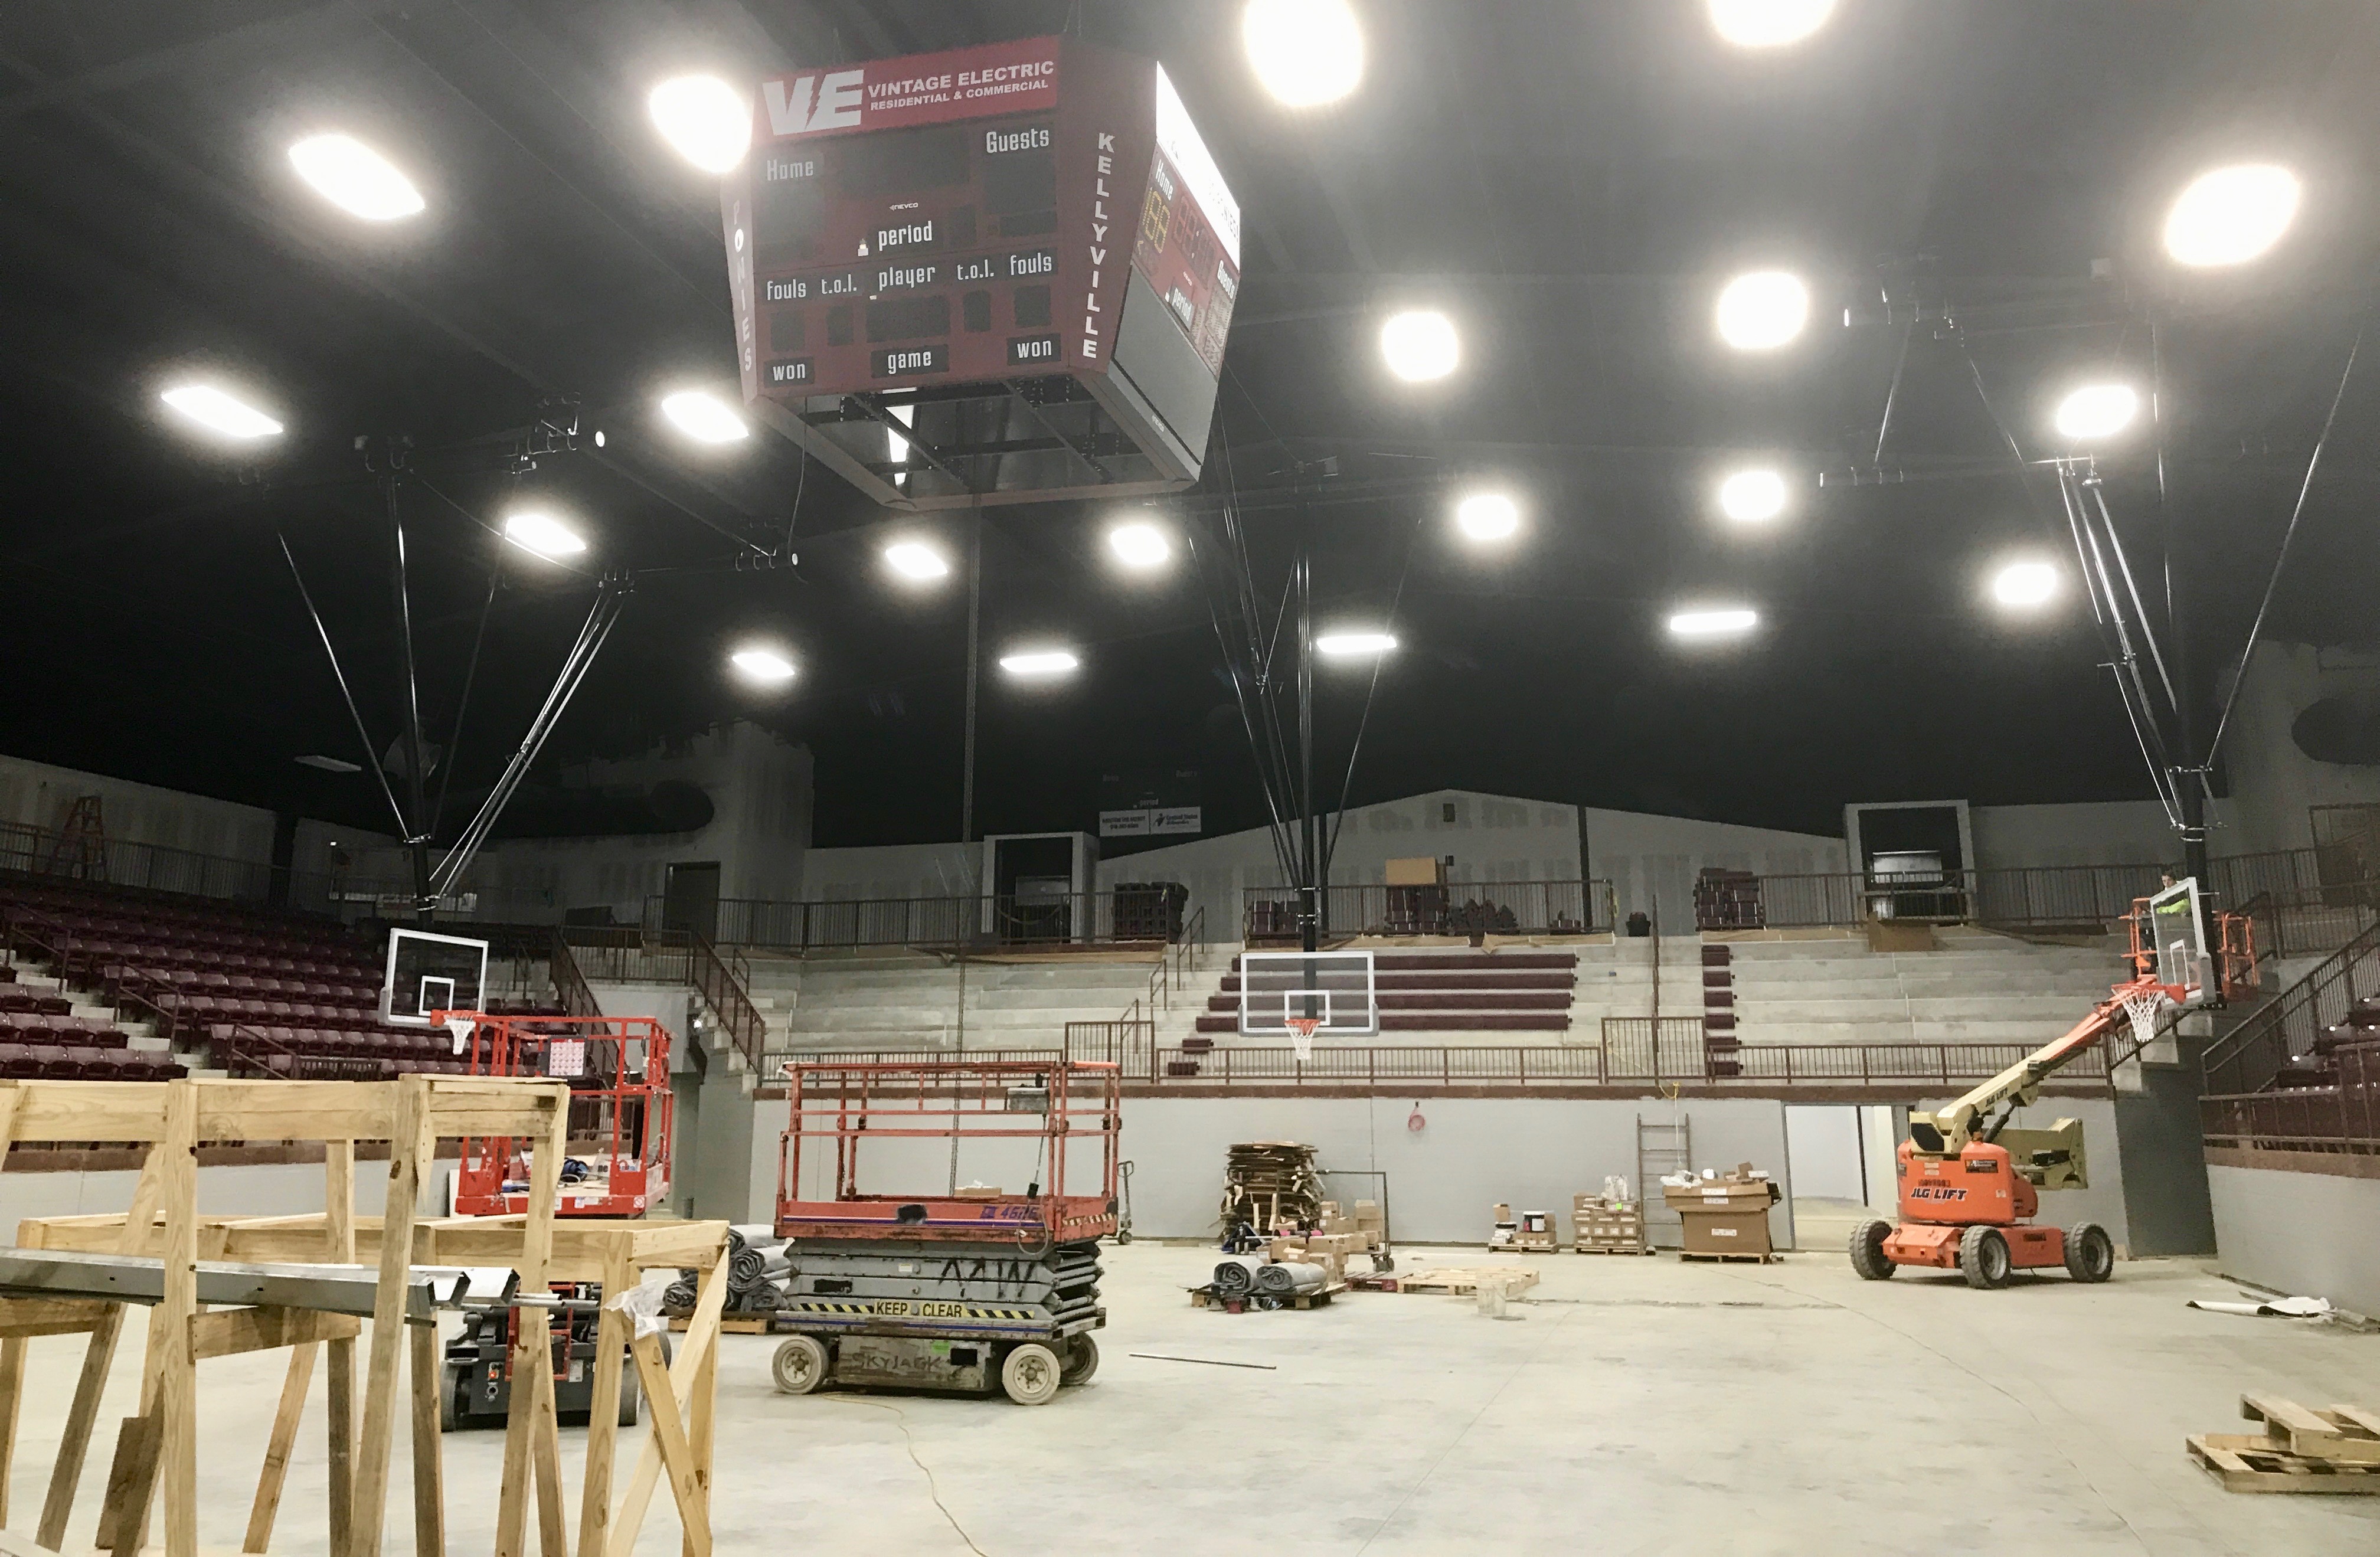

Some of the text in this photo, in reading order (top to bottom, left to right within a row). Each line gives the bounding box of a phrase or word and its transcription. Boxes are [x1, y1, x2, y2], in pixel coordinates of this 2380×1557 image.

[868, 60, 1054, 99] VINTAGE ELECTRIC
[870, 78, 1048, 111] RESIDENTIAL & COMMERCIAL
[762, 69, 864, 136] VE
[986, 128, 1050, 153] Guests
[767, 159, 814, 181] Home
[1155, 159, 1173, 201] Home
[878, 220, 933, 251] period
[1083, 132, 1115, 359] KELLYVILLE
[733, 199, 752, 371] PONIES
[767, 252, 1052, 301] fouls t.o.l. player t.o.l. fouls
[1217, 260, 1235, 300] Guests
[1172, 287, 1192, 322] period
[773, 339, 1052, 381] won game won
[1996, 1087, 2008, 1100] LIFT
[1911, 1188, 1967, 1201] JLG LIFT
[877, 1301, 962, 1318] KEEP CLEAR
